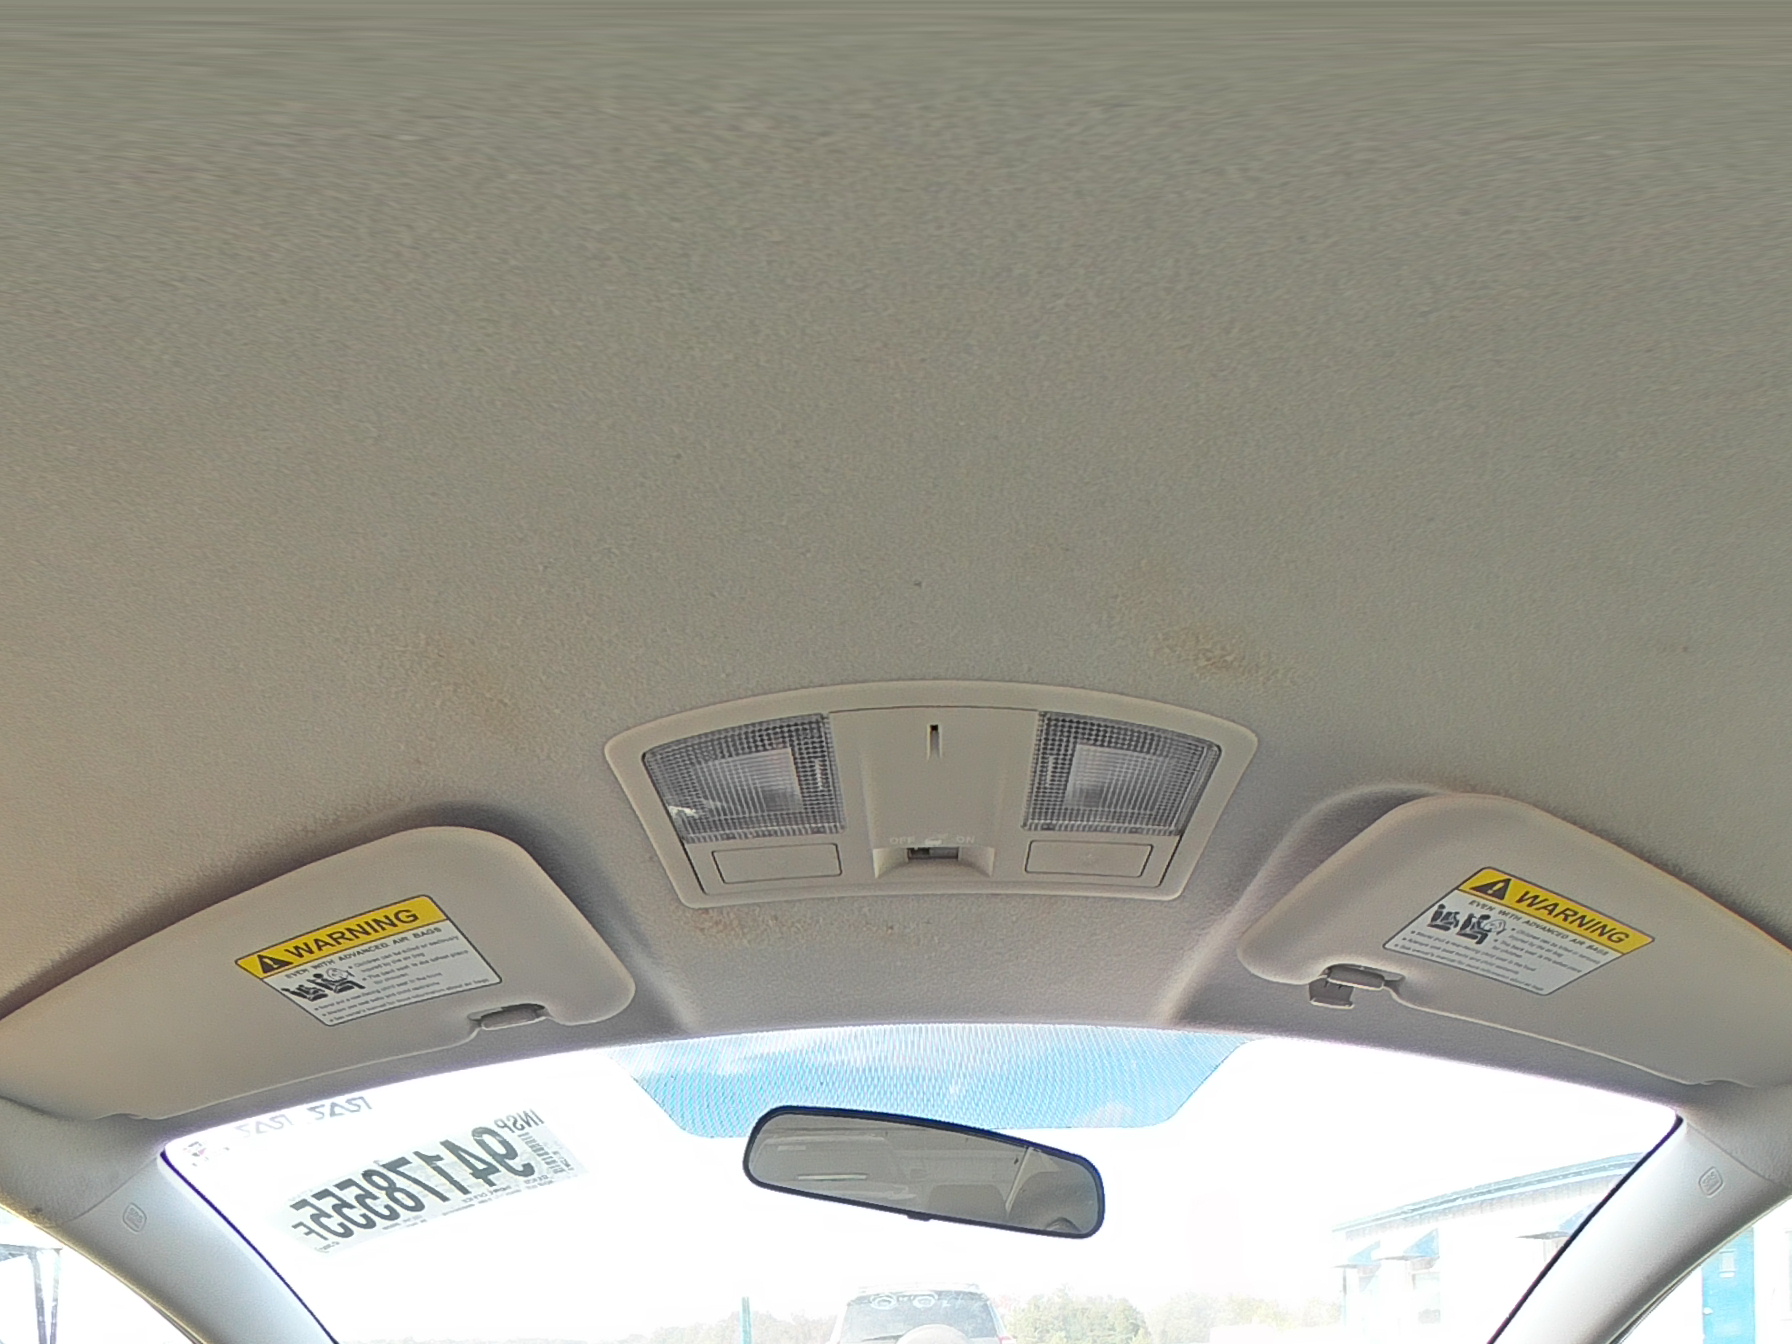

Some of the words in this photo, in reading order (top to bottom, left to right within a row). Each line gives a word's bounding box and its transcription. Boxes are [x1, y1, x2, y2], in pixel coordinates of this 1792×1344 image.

[284, 908, 419, 960] WARNING
[1467, 898, 1497, 912] EVEN
[1495, 909, 1522, 922] WITH
[1519, 919, 1570, 940] ADVANCED
[1516, 890, 1630, 944] WARNING
[310, 958, 337, 970] WITH
[389, 935, 410, 945] AIR
[410, 924, 442, 938] BAGS
